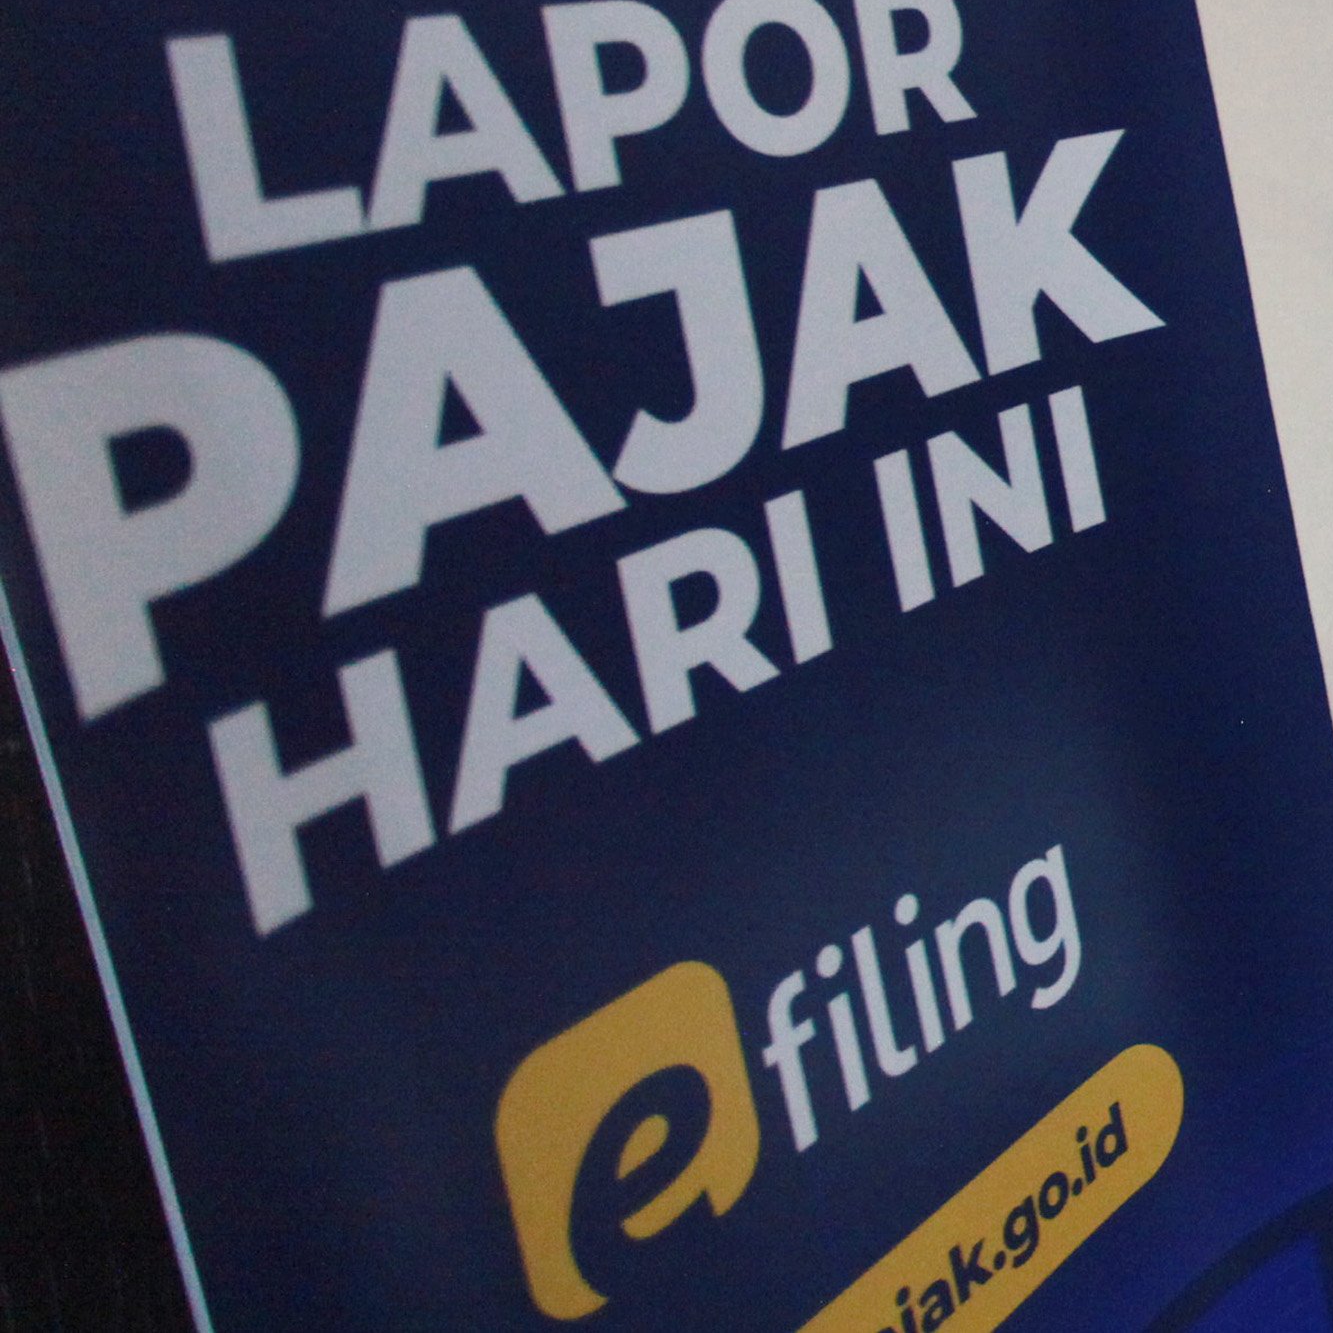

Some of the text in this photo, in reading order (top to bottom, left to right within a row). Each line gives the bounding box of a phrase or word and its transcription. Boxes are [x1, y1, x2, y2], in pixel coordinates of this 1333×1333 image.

[0, 128, 1166, 725] PAJAK
[209, 385, 1106, 934] HARI INI
[876, 1102, 1130, 1333] jak.go.id
